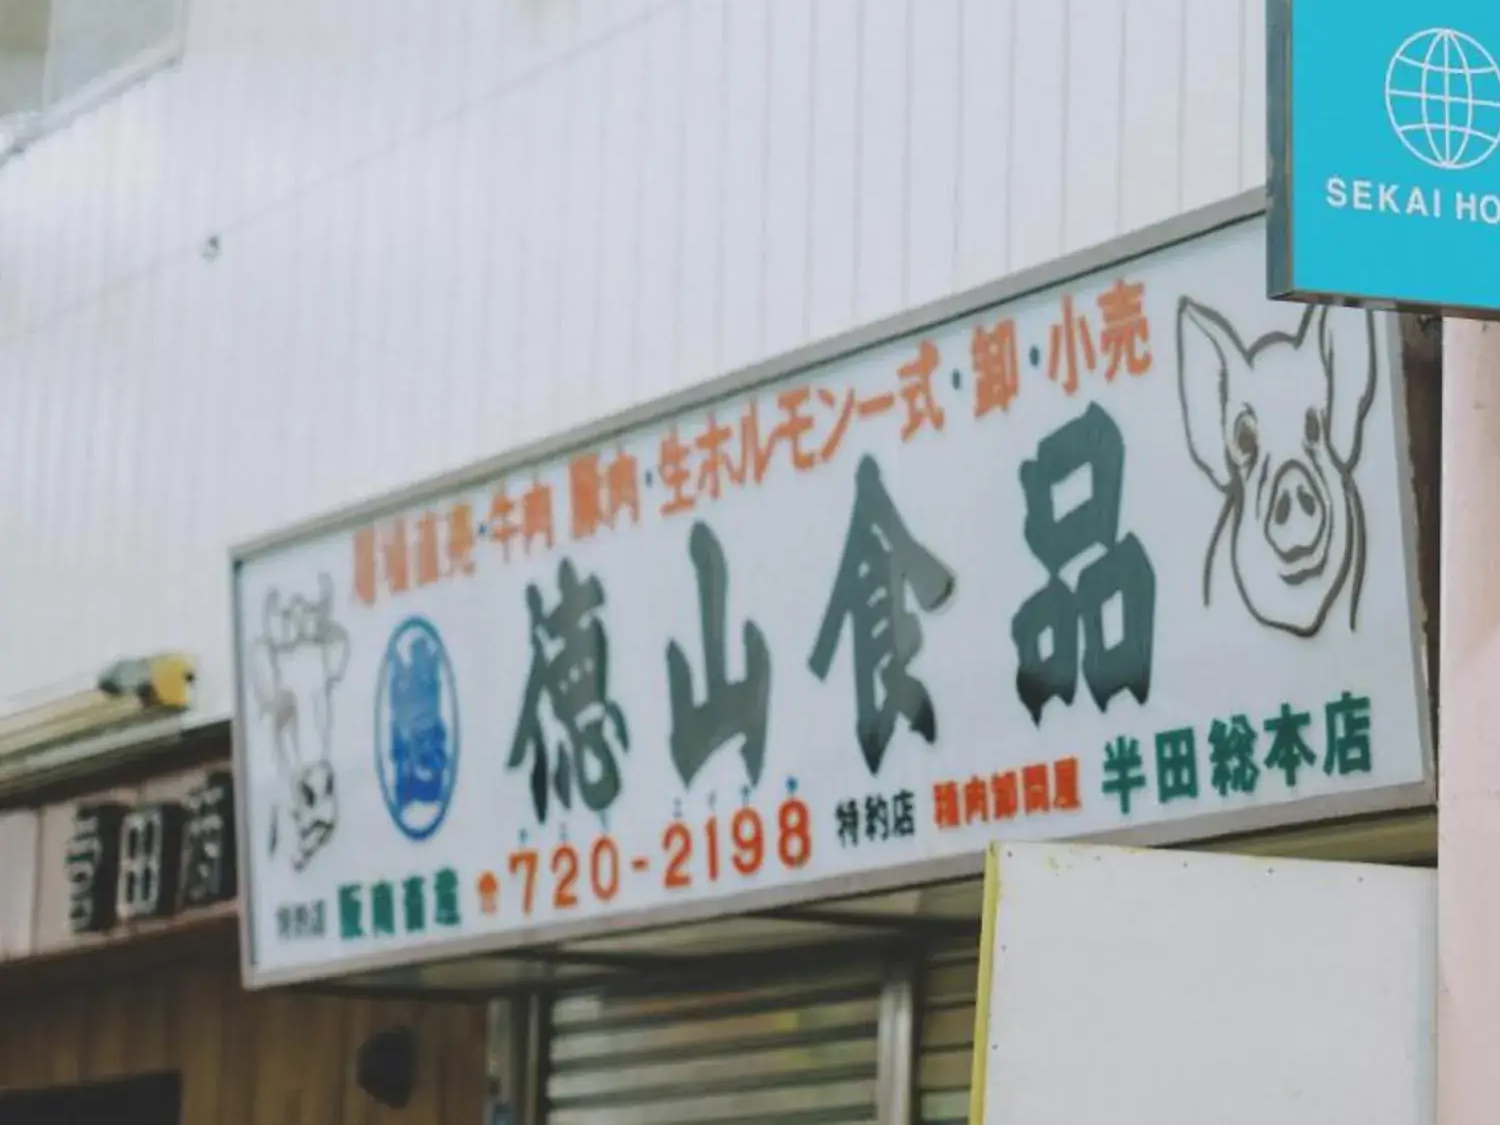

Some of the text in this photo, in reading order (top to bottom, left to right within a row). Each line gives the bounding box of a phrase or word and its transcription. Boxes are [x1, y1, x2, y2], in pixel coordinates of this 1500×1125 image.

[1326, 177, 1442, 218] SEKAI
[503, 400, 1156, 824] 徳山食品
[508, 797, 811, 914] 720-2198
[1102, 692, 1373, 814] 半田総本店
